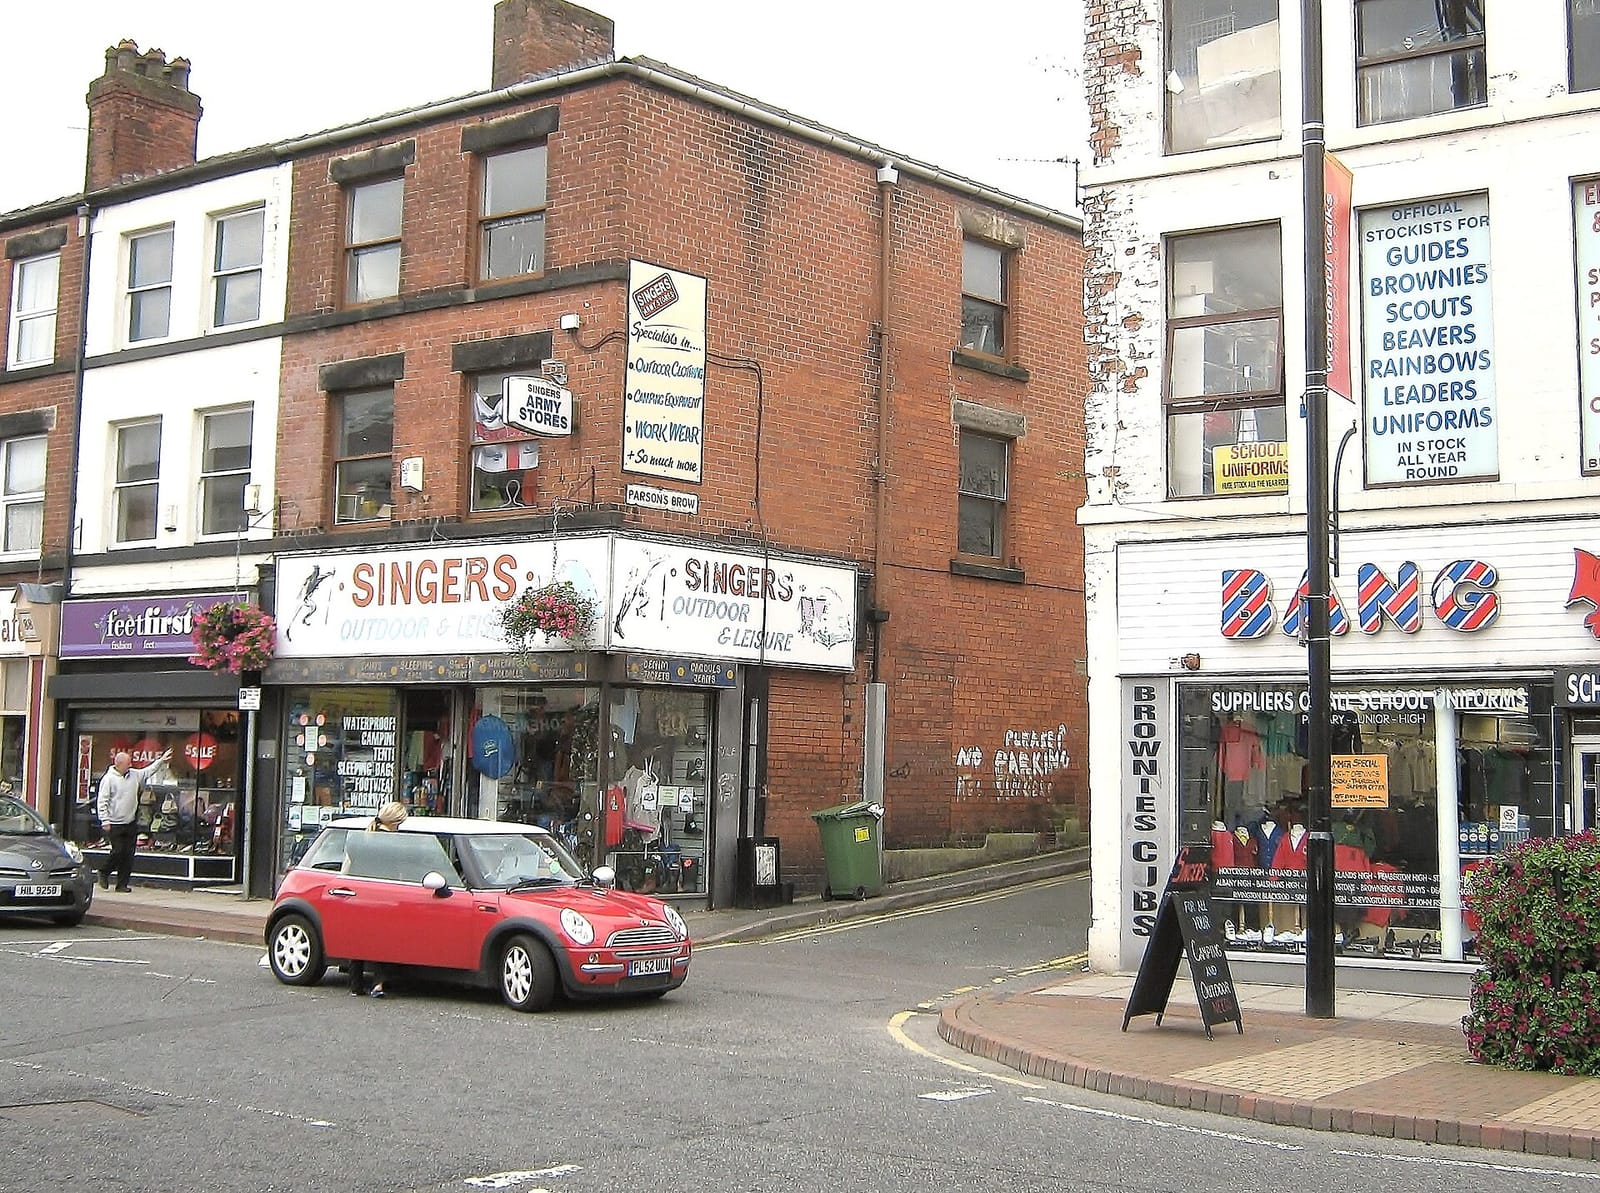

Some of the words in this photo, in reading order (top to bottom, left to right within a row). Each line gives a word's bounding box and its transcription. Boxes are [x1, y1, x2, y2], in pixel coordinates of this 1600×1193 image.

[1391, 201, 1463, 221] OFFICIAL
[1366, 220, 1452, 242] STOCKISTS
[1458, 215, 1490, 230] FOR
[1386, 237, 1469, 266] GUIDES
[637, 278, 672, 306] SINGERS
[1370, 263, 1488, 297] BROWNIES
[1386, 295, 1473, 323] SCOUTS
[631, 320, 678, 345] Specialists
[1383, 323, 1477, 351] BEAVERS
[1370, 349, 1491, 379] RAINBOWS
[526, 394, 562, 414] ARMY
[527, 383, 561, 400] SINGERS
[1384, 379, 1478, 406] LEADERS
[519, 407, 568, 429] STORES
[1372, 406, 1493, 436] UNIFORMS
[635, 419, 667, 443] WORK
[669, 421, 700, 445] WEAR
[1231, 443, 1284, 459] SCHOOL
[1397, 442, 1412, 453] IN
[1416, 437, 1466, 452] STOCK
[635, 448, 649, 464] So
[649, 455, 674, 469] much
[676, 459, 698, 473] more
[1222, 460, 1288, 477] UNIFORMS
[1397, 453, 1424, 467] ALL
[1428, 451, 1467, 464] YEAR
[1406, 465, 1458, 479] ROUND
[628, 489, 669, 506] PARSON'S
[671, 495, 696, 510] BROW
[351, 554, 518, 608] SINGERS
[685, 557, 794, 602] SINGERS
[673, 595, 750, 623] OUTDOOR
[1221, 559, 1501, 639] BANG
[340, 614, 430, 641] OUTDOOR
[436, 616, 449, 638] &
[717, 627, 731, 645] &
[732, 627, 793, 652] LEISURE
[1211, 691, 1294, 713] SUPPLIERS
[1357, 690, 1429, 711] SCHOOL
[1433, 687, 1529, 709] UNIFORMS
[1398, 713, 1426, 725] HIGH
[80, 738, 91, 800] SALE
[133, 751, 163, 763] SALE
[337, 761, 372, 776] SLEEPING
[1128, 685, 1161, 832] BROWNIES
[350, 791, 394, 809] WORKWEA
[20, 886, 34, 895] HIL
